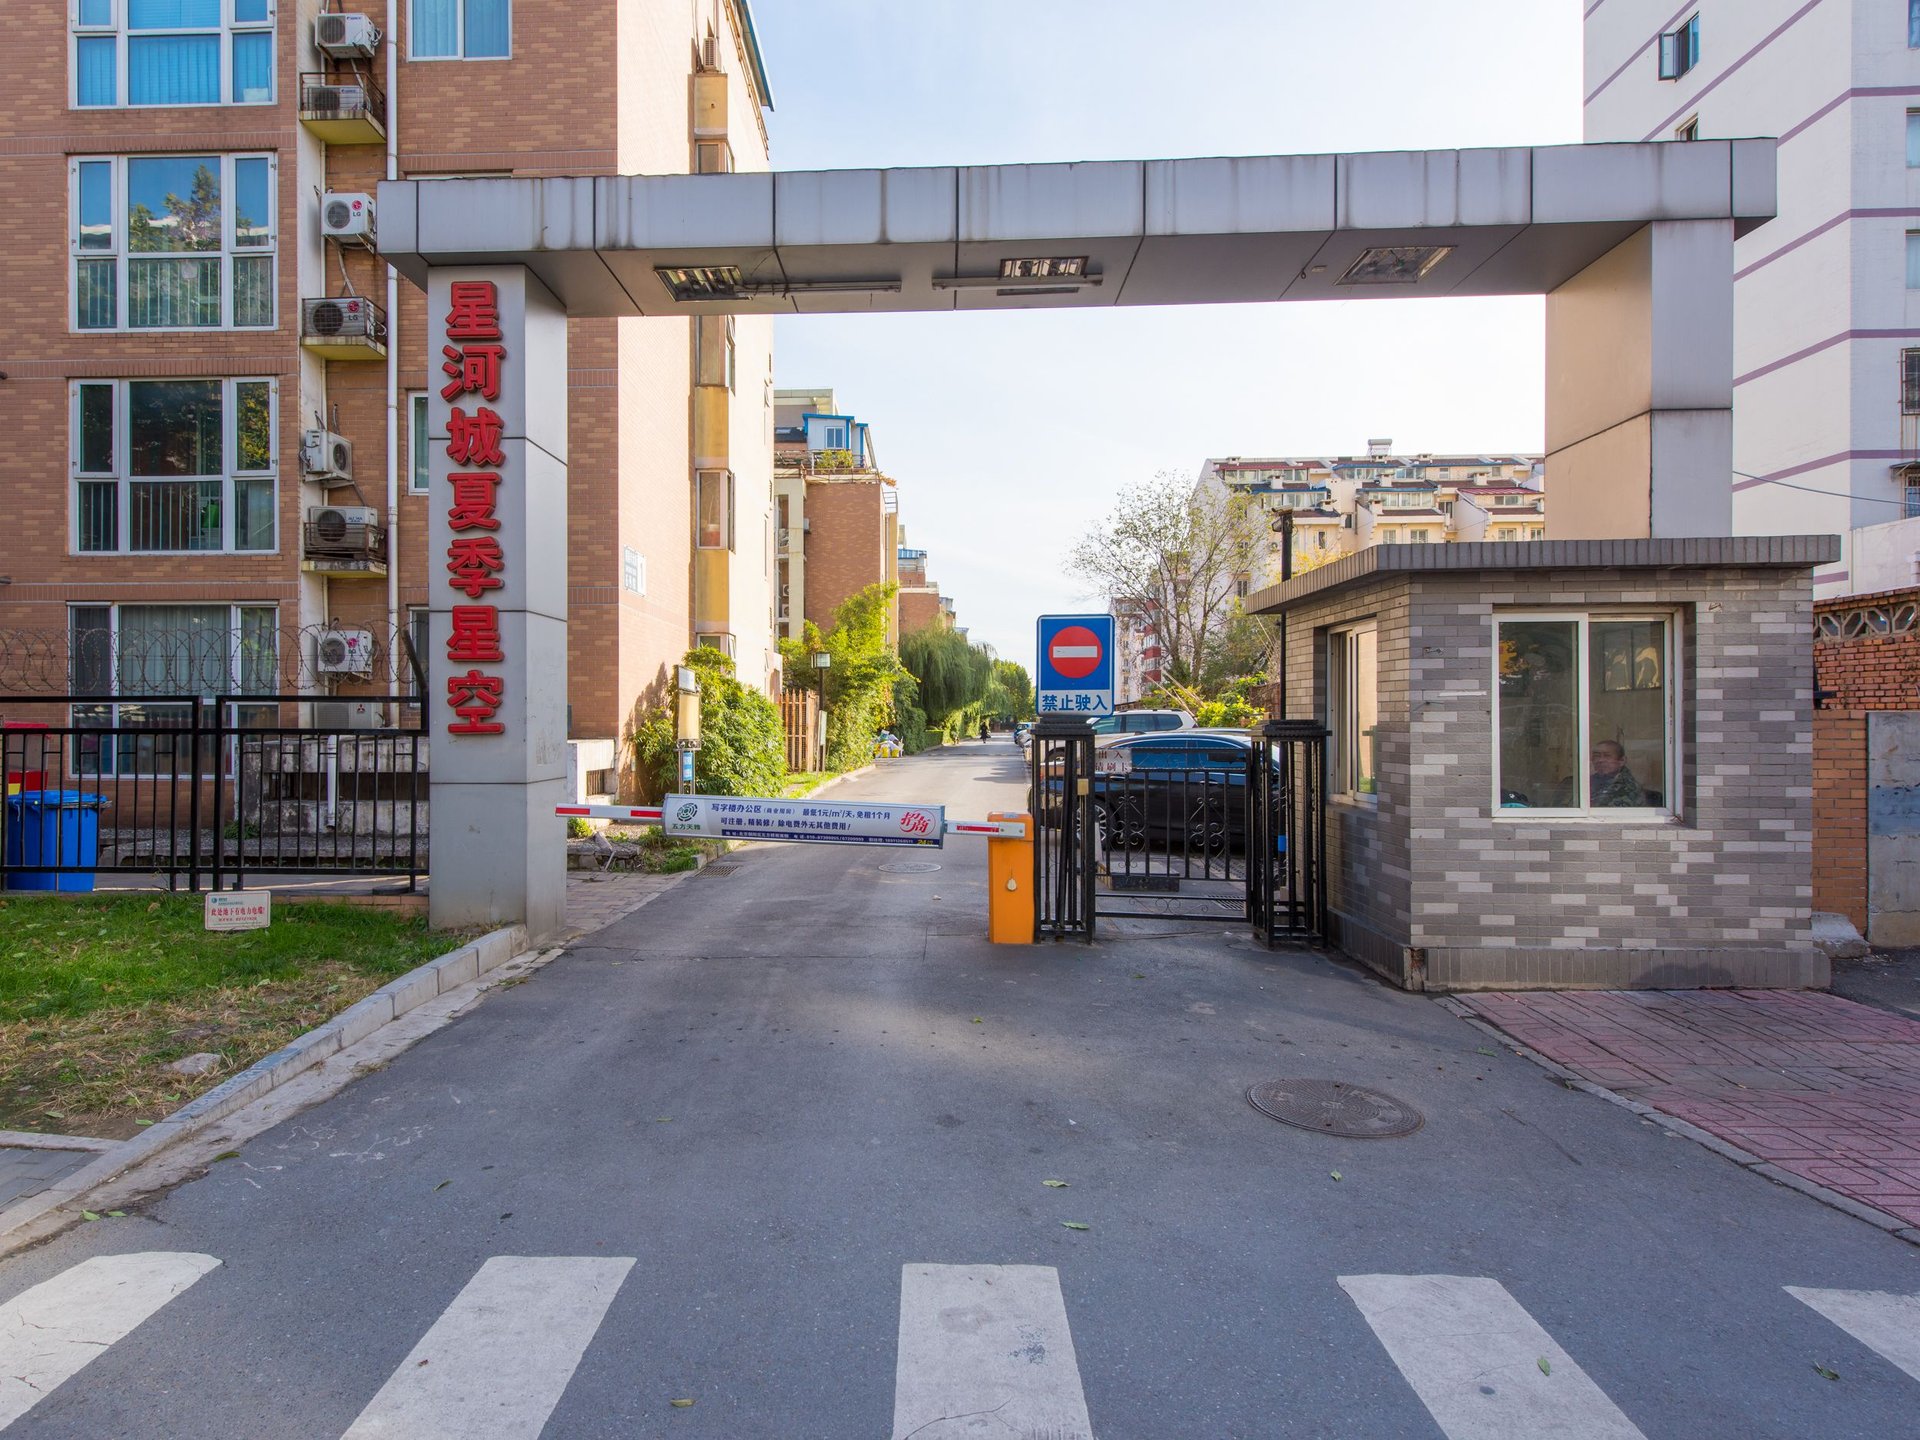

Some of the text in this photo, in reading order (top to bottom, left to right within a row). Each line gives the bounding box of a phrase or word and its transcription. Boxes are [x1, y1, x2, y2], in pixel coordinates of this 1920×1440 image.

[440, 280, 506, 736] 星河城夏季星空
[1042, 694, 1108, 712] 禁止驶入
